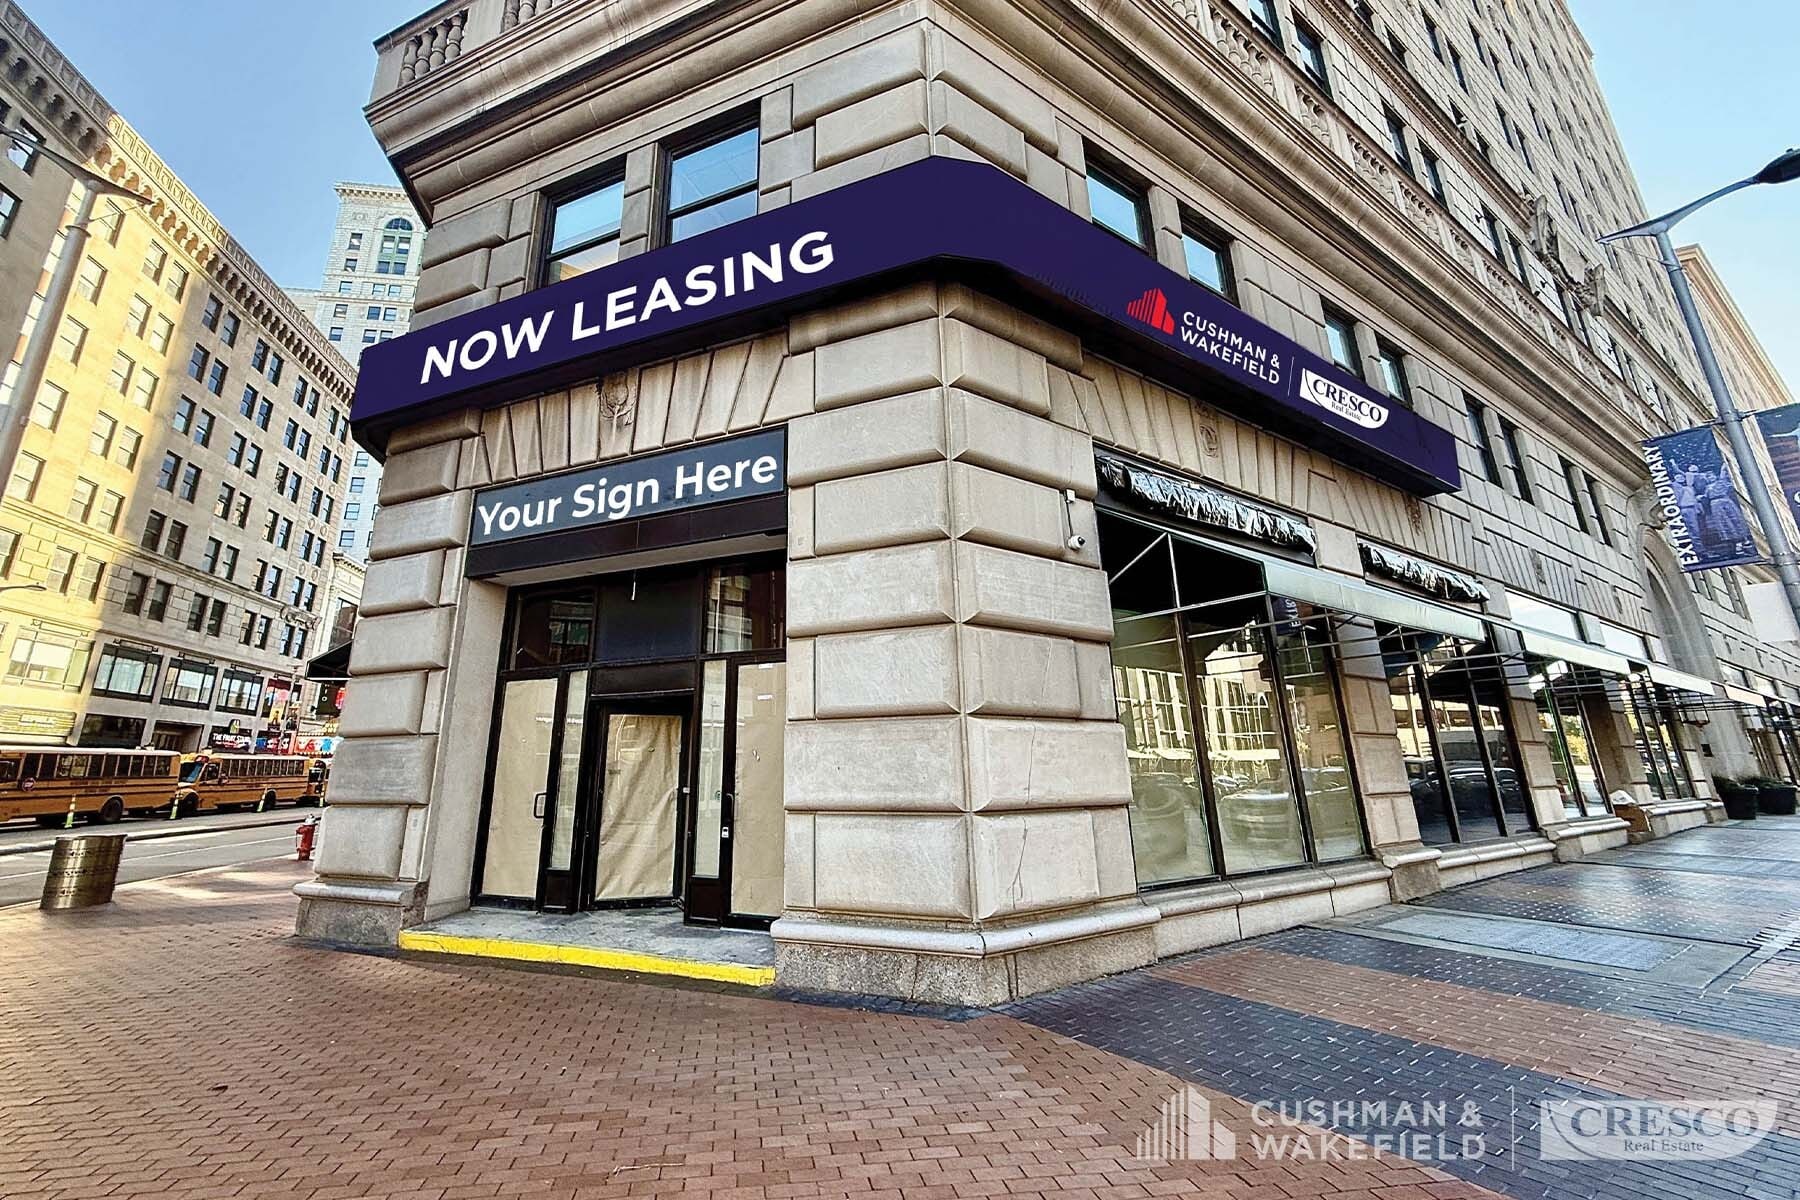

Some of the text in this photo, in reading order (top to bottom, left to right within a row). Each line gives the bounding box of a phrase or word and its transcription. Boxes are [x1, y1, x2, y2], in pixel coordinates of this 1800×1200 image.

[420, 231, 834, 384] NOW LEASING
[1180, 326, 1280, 384] WAKEFIELD
[1183, 311, 1280, 369] CUSHMAN &
[1313, 379, 1382, 422] CRESCO
[1331, 401, 1345, 413] Real
[477, 455, 778, 536] Your Sign Here
[1642, 445, 1699, 566] EXTRAORDINARY
